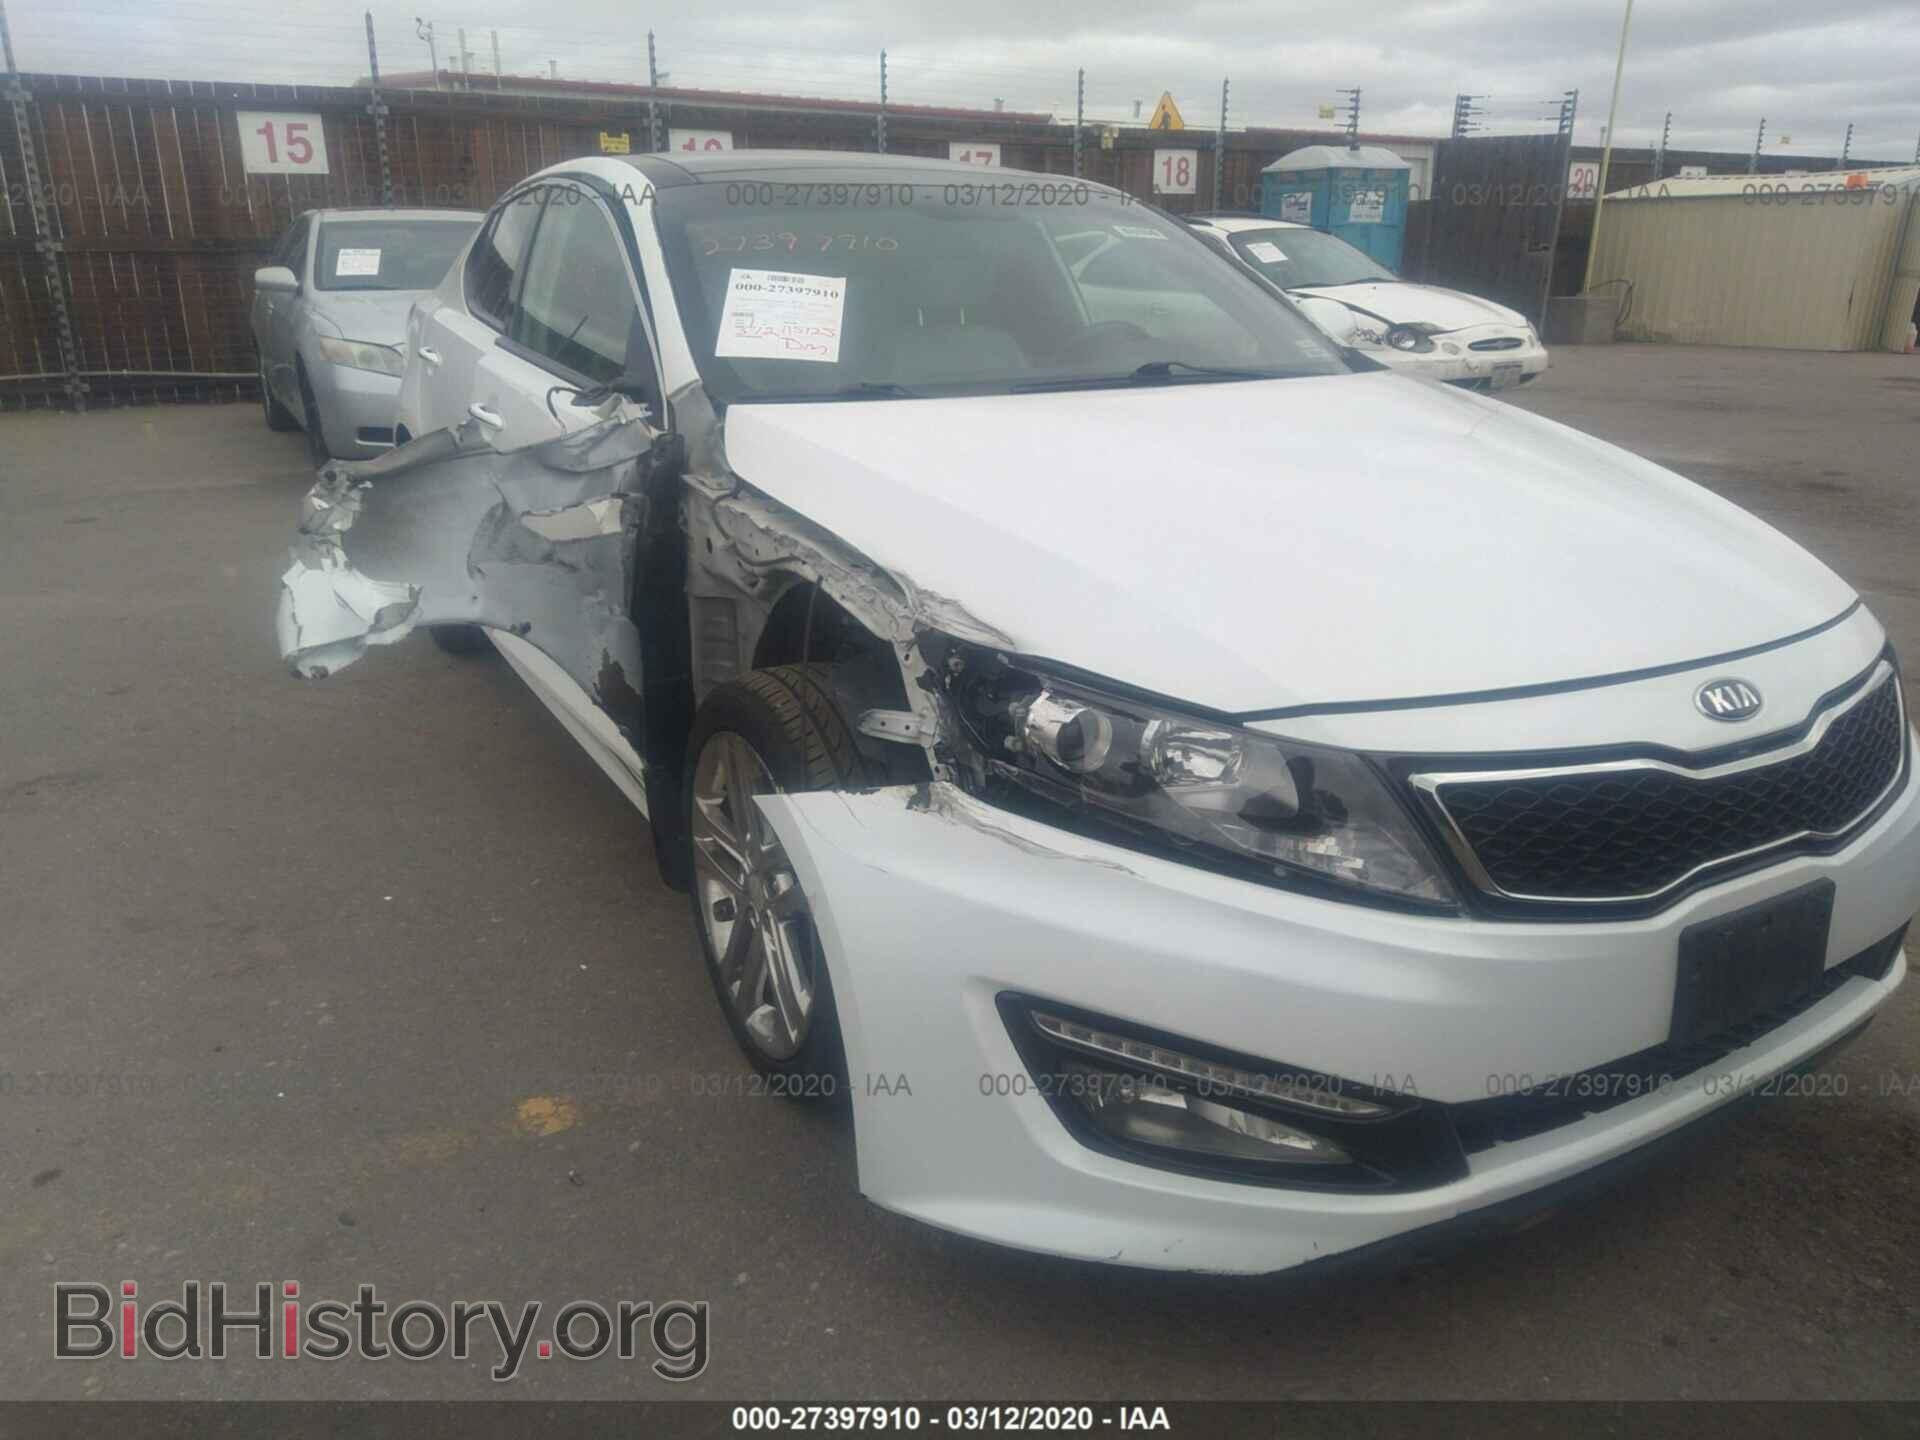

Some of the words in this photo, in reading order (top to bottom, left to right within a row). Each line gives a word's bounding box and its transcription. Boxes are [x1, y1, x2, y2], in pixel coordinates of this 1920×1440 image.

[256, 121, 314, 165] 15
[1161, 156, 1190, 187] 18
[1575, 168, 1594, 193] 20
[735, 283, 840, 299] 000-27397910
[1703, 683, 1760, 713] KIA
